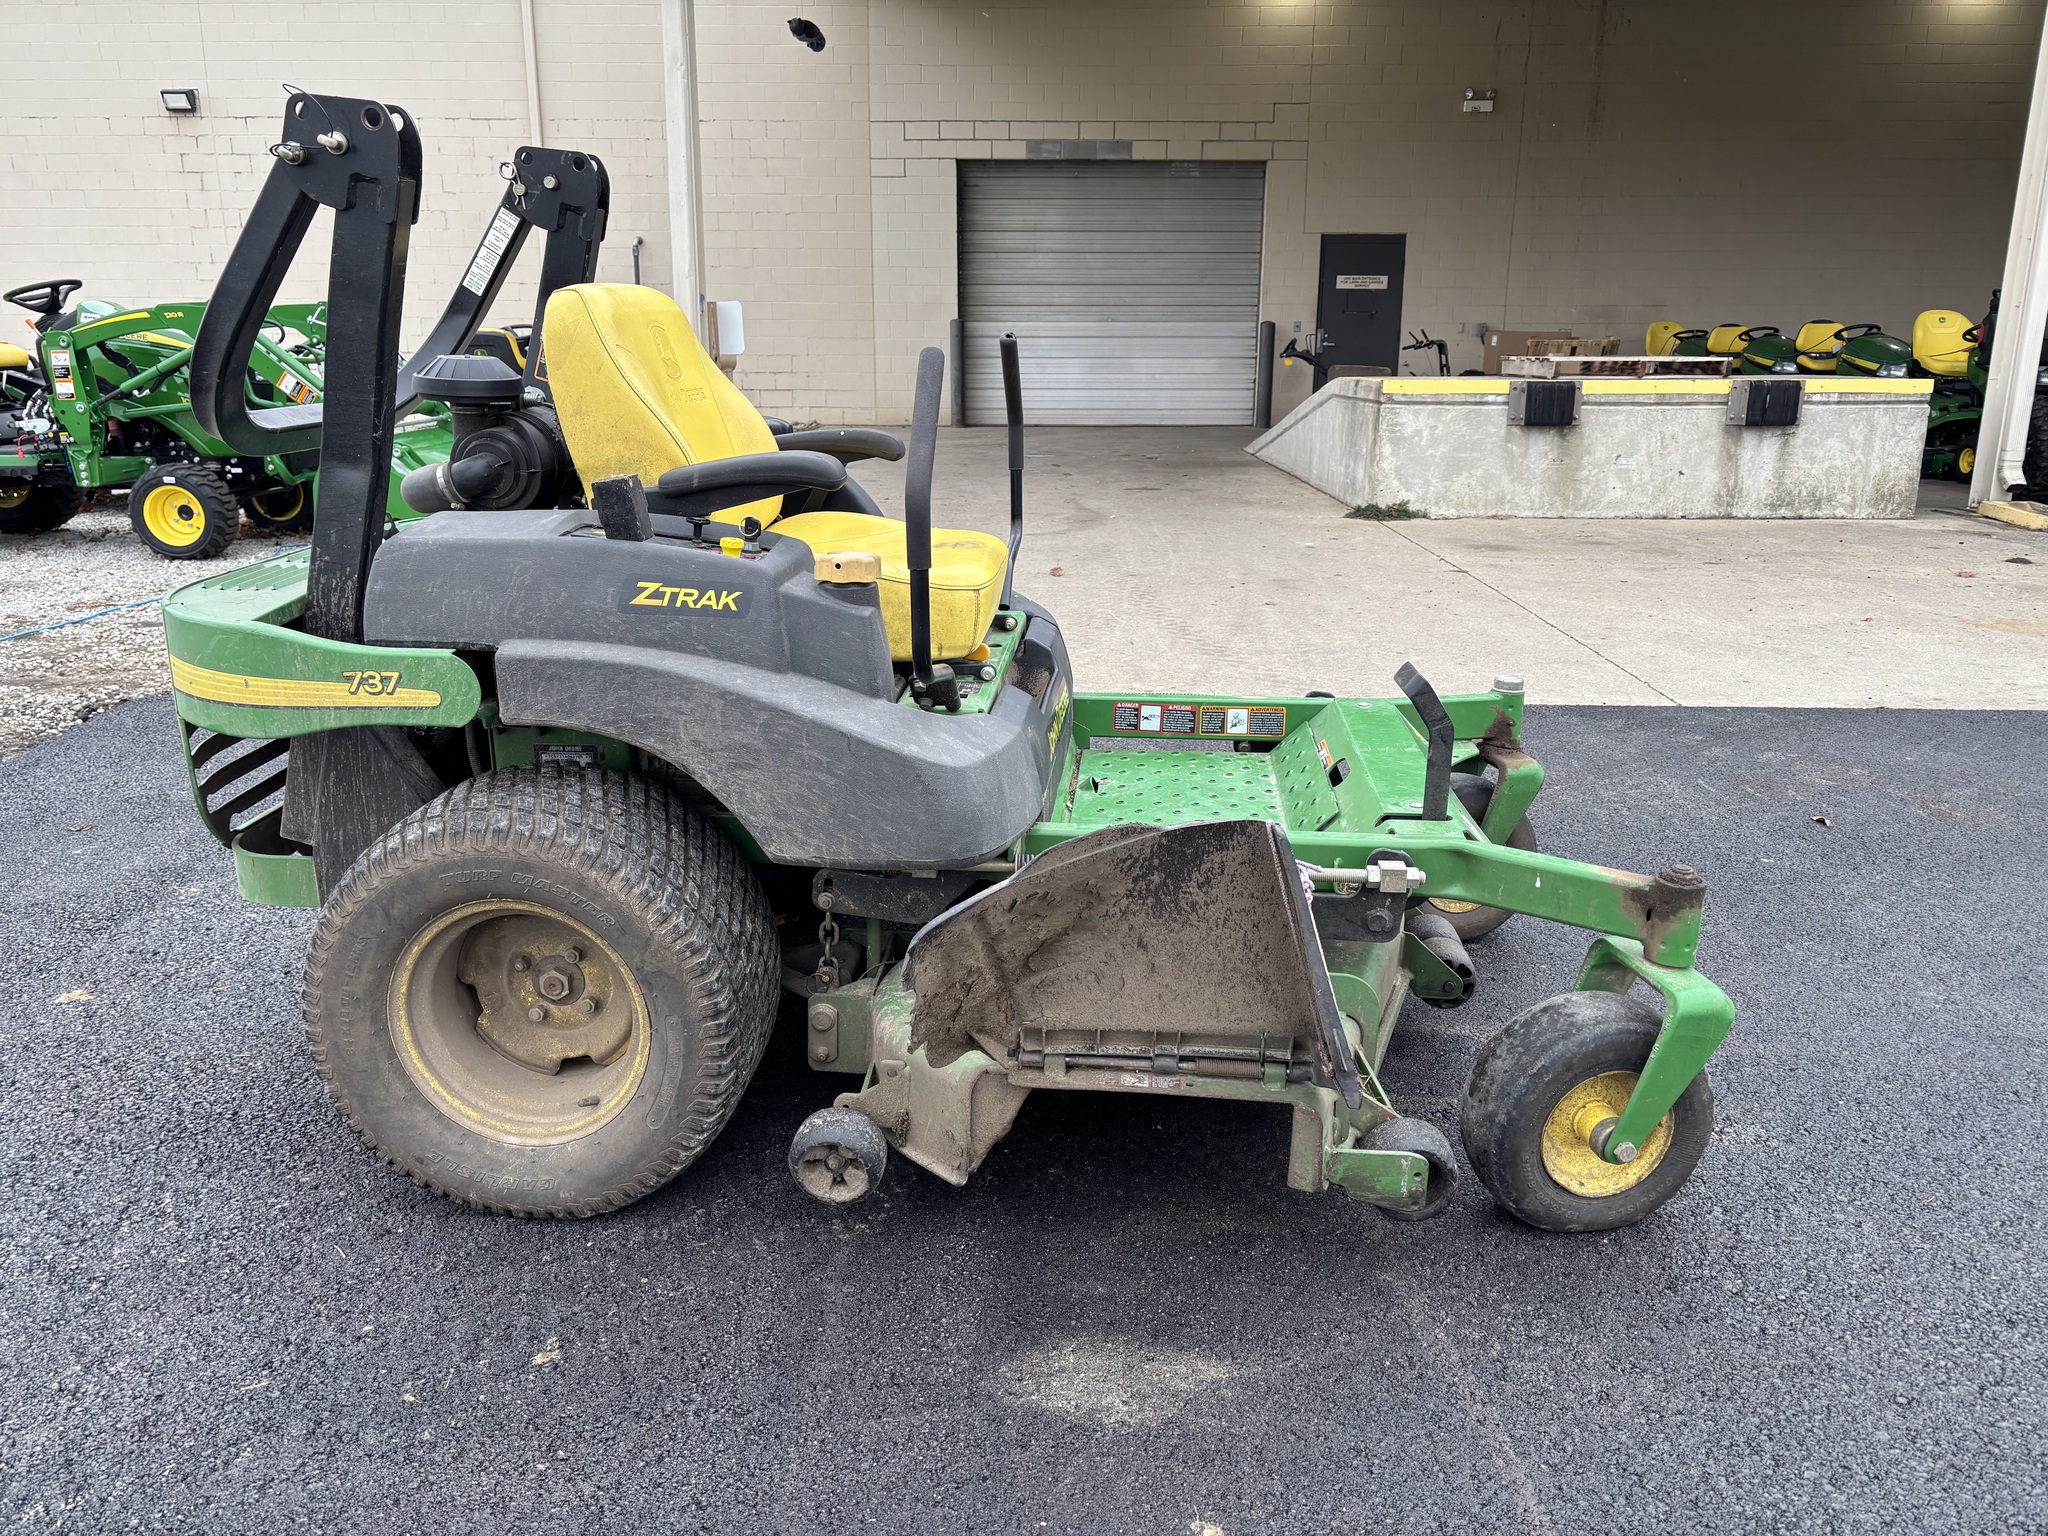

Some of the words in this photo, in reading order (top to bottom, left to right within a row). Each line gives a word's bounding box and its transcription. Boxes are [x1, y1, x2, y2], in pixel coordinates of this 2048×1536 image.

[629, 581, 743, 611] ZTRAK
[341, 670, 402, 696] 737
[438, 869, 503, 887] TURF
[510, 872, 616, 929] MASTER
[425, 1149, 558, 1191] CARLISLE
[1607, 1176, 1674, 1221] CARLISLE
